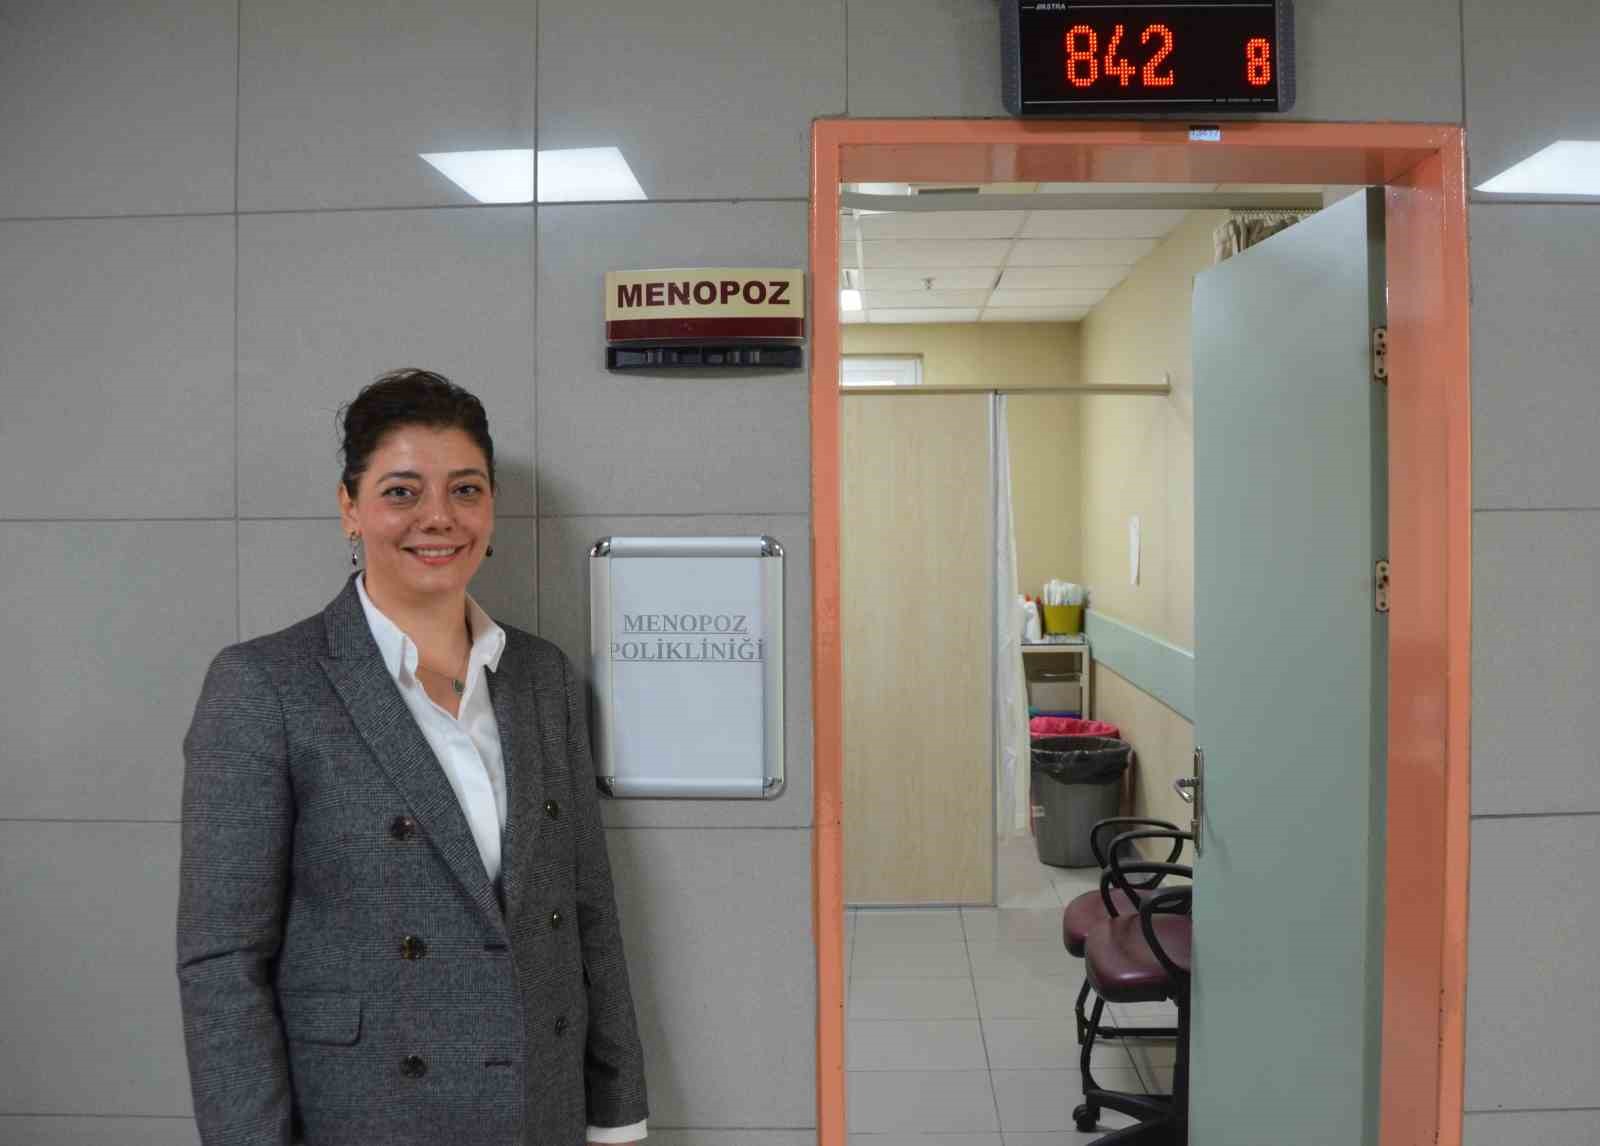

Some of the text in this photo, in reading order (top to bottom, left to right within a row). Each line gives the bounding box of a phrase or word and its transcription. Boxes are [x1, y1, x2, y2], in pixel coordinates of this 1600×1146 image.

[1065, 24, 1270, 87] 842 8
[617, 280, 790, 308] MENOPOZ
[623, 614, 748, 633] MENOPOZ
[610, 637, 764, 660] POLİKLİNİĞİ
